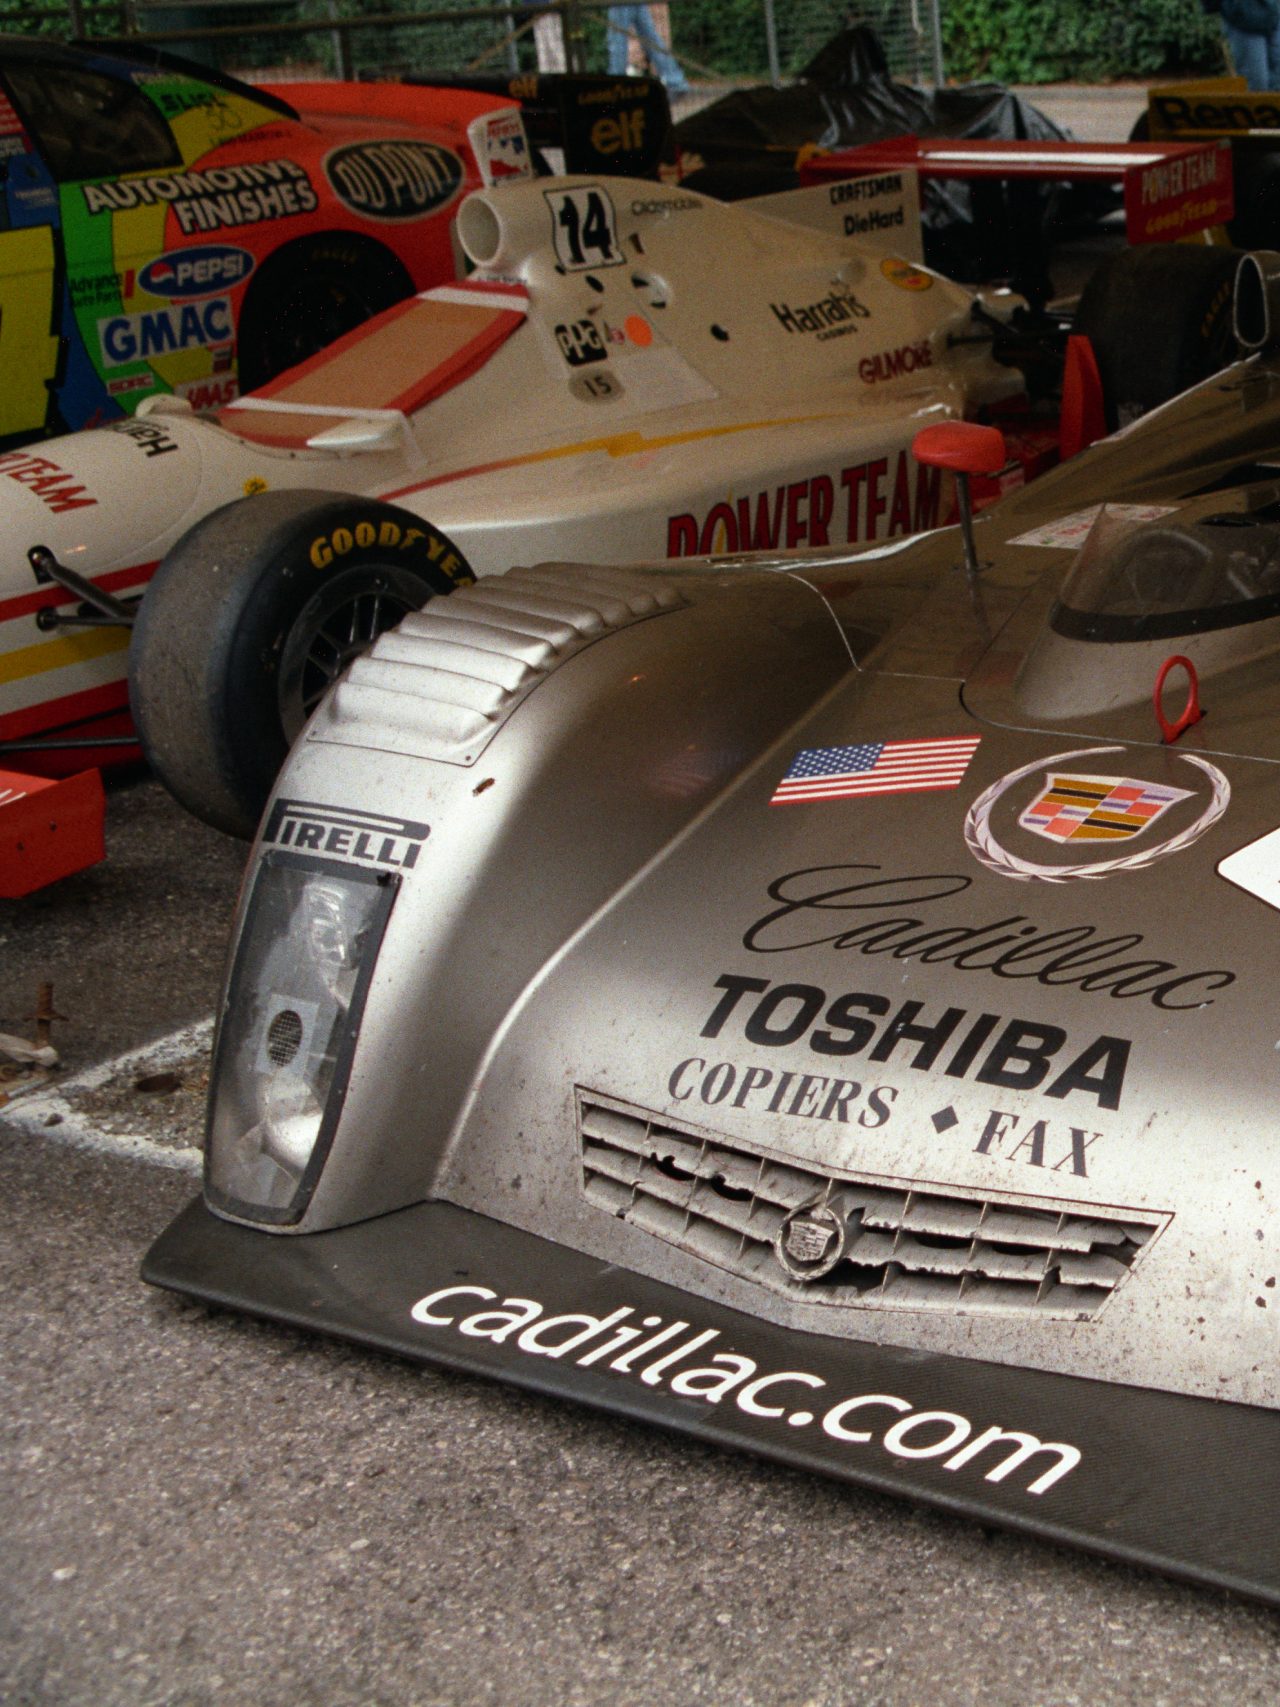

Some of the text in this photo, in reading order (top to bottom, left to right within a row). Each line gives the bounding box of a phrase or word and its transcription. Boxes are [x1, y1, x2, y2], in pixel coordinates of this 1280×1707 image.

[590, 106, 646, 155] elf
[83, 159, 306, 214] AUTOMOTIVE
[829, 174, 902, 206] CRAFTSMAN
[1141, 149, 1217, 206] POWER TEAM
[173, 179, 318, 234] FINISHES
[559, 192, 614, 264] 14
[843, 206, 904, 236] DieHard
[176, 253, 244, 287] PEPSI
[104, 300, 230, 362] GMAC
[583, 376, 612, 398] 15
[858, 339, 934, 384] GILMORE
[0, 457, 99, 514] TEAM
[666, 474, 835, 558] POWER
[840, 449, 942, 544] TEAM
[262, 798, 431, 870] PIRELLI
[742, 864, 1236, 1011] Cadillac
[700, 973, 1133, 1111] TOSHIBA
[667, 1056, 1105, 1178] COPIERS FAX
[410, 1285, 1082, 1495] cadillac.com
